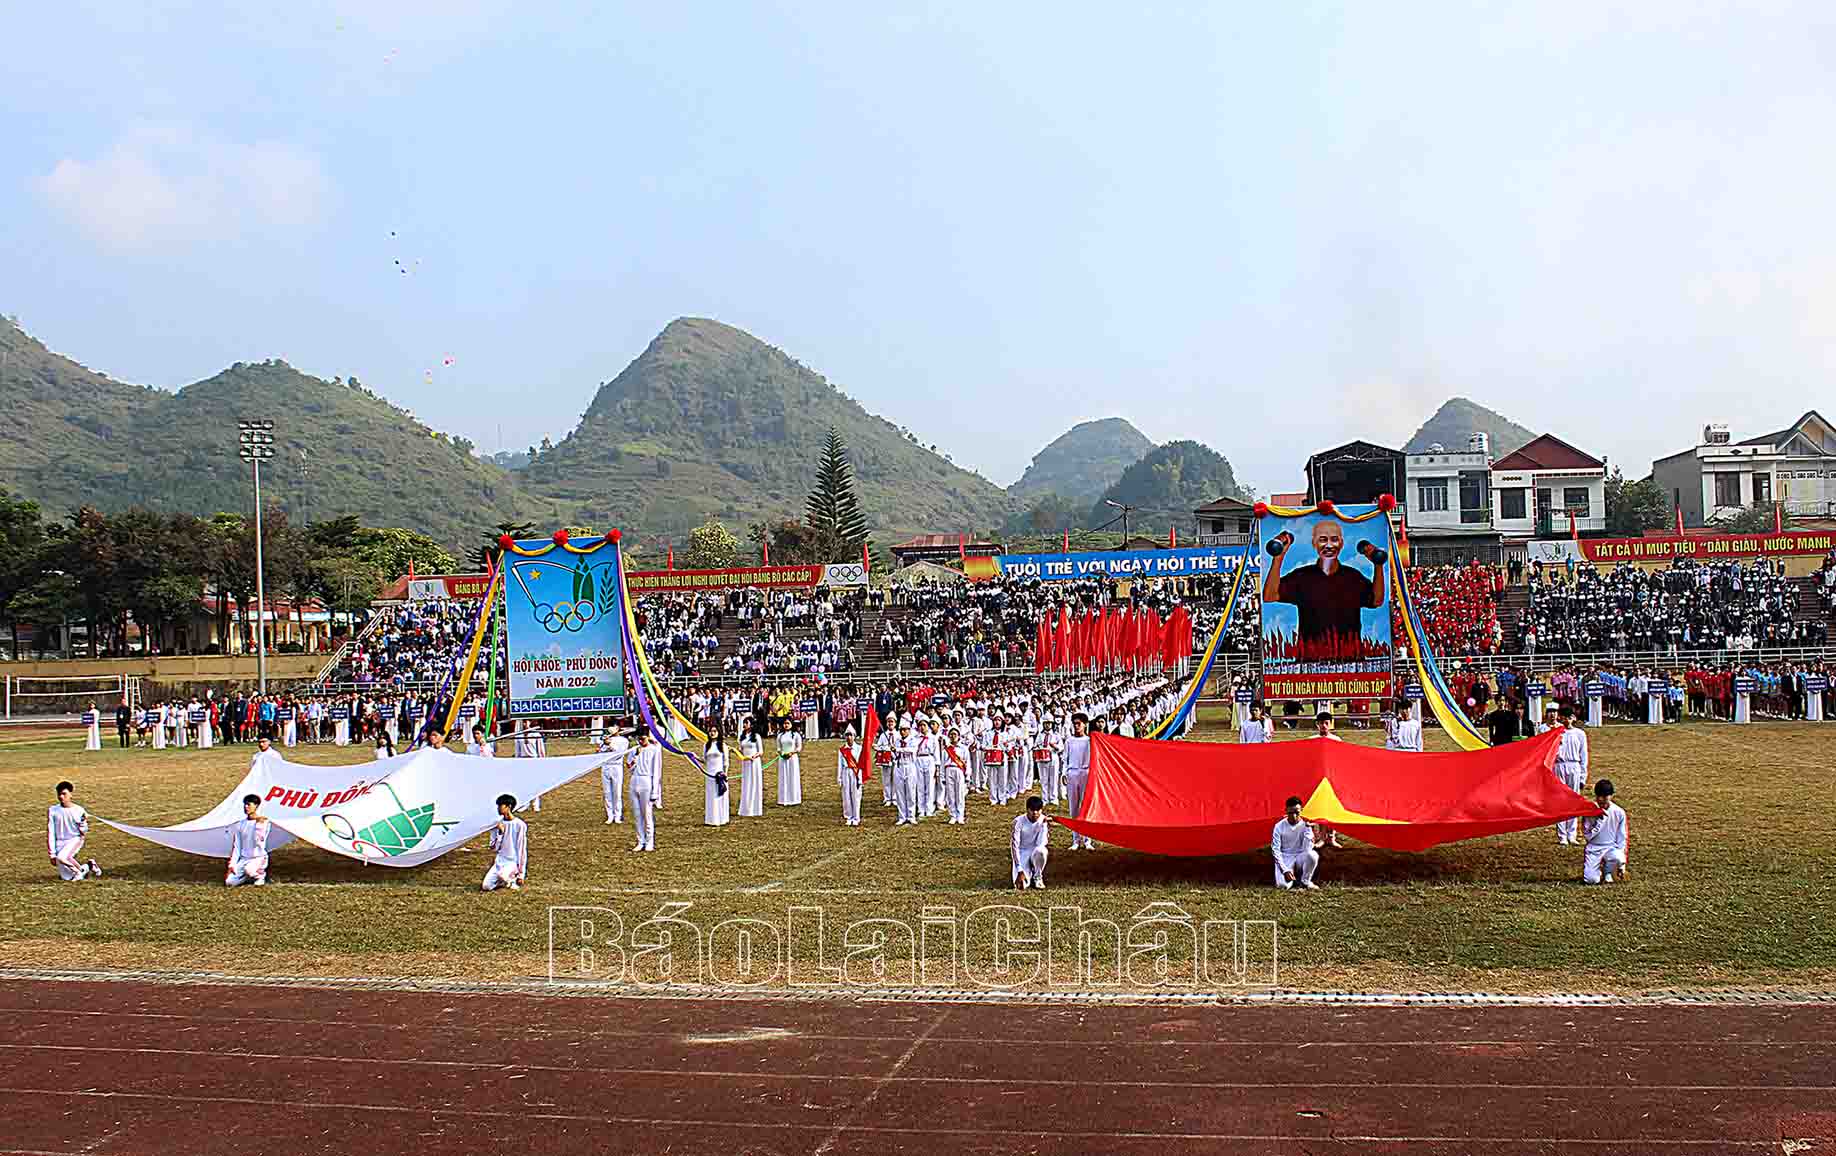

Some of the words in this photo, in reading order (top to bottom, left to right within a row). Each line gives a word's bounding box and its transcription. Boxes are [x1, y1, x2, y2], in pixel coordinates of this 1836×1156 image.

[1595, 540, 1614, 557] TẤT
[1616, 540, 1631, 556] CẢ
[1633, 541, 1643, 556] VÌ
[1646, 542, 1670, 557] MỤC
[1673, 539, 1696, 554] TIÊU
[1732, 537, 1761, 552] GIÀU,
[1764, 536, 1794, 551] NƯỚC
[1005, 557, 1041, 576] TUỔI
[1045, 558, 1073, 575] TRẺ
[1077, 558, 1105, 574] VỚI
[1110, 556, 1153, 573] NGÀY
[1157, 555, 1184, 573] HỘI
[1189, 550, 1218, 570] THỂ
[709, 570, 728, 586] QUYẾT
[782, 568, 796, 582] CÁC
[513, 657, 531, 676] HỘI
[534, 654, 561, 672] KHỎE
[566, 654, 587, 671] PHÙ
[536, 675, 564, 689] NĂM
[568, 676, 597, 688] 2022
[1282, 679, 1294, 695] TÔI
[1295, 679, 1316, 695] NGÀY
[1317, 678, 1333, 694] NÀO
[1334, 678, 1347, 694] TÔI
[1348, 678, 1369, 694] CŨNG
[264, 785, 319, 809] PHÙ
